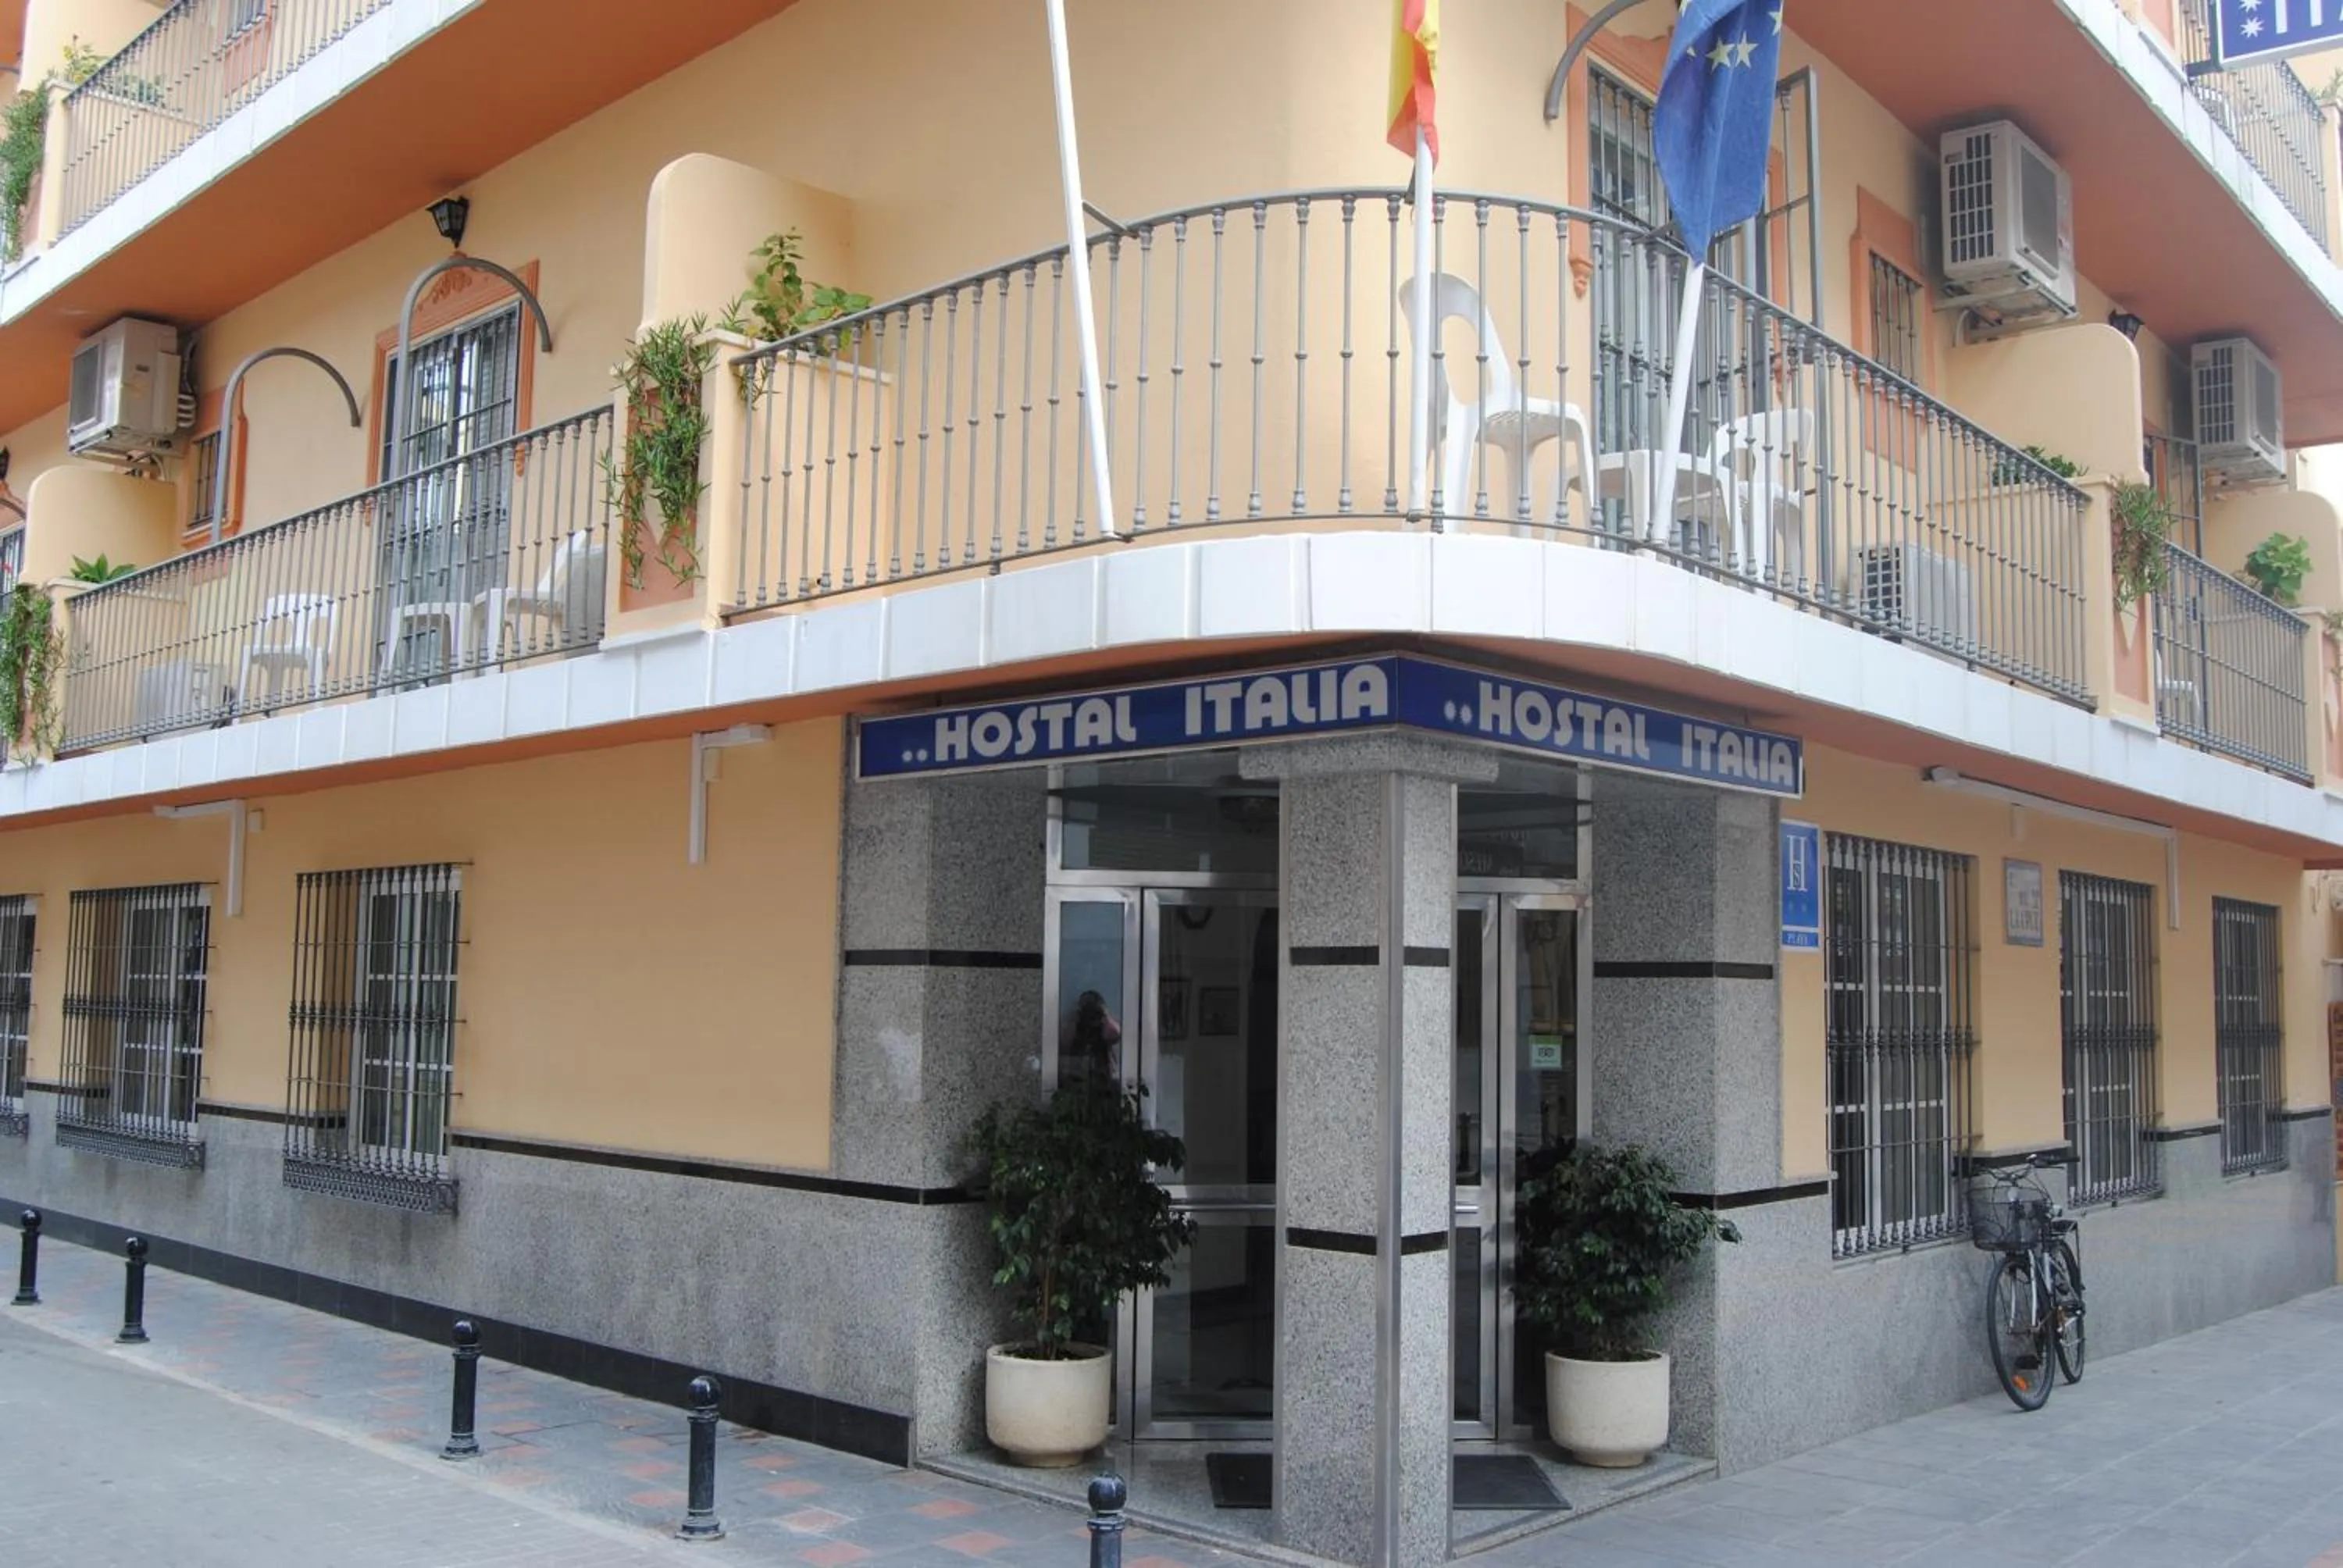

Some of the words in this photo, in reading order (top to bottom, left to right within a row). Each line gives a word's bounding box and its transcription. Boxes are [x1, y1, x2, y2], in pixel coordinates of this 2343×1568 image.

[935, 695, 1137, 762] HOSTAL
[1184, 664, 1389, 736] ITALIA
[1479, 680, 1650, 761] HOSTAL
[1681, 723, 1794, 786] ITALIA
